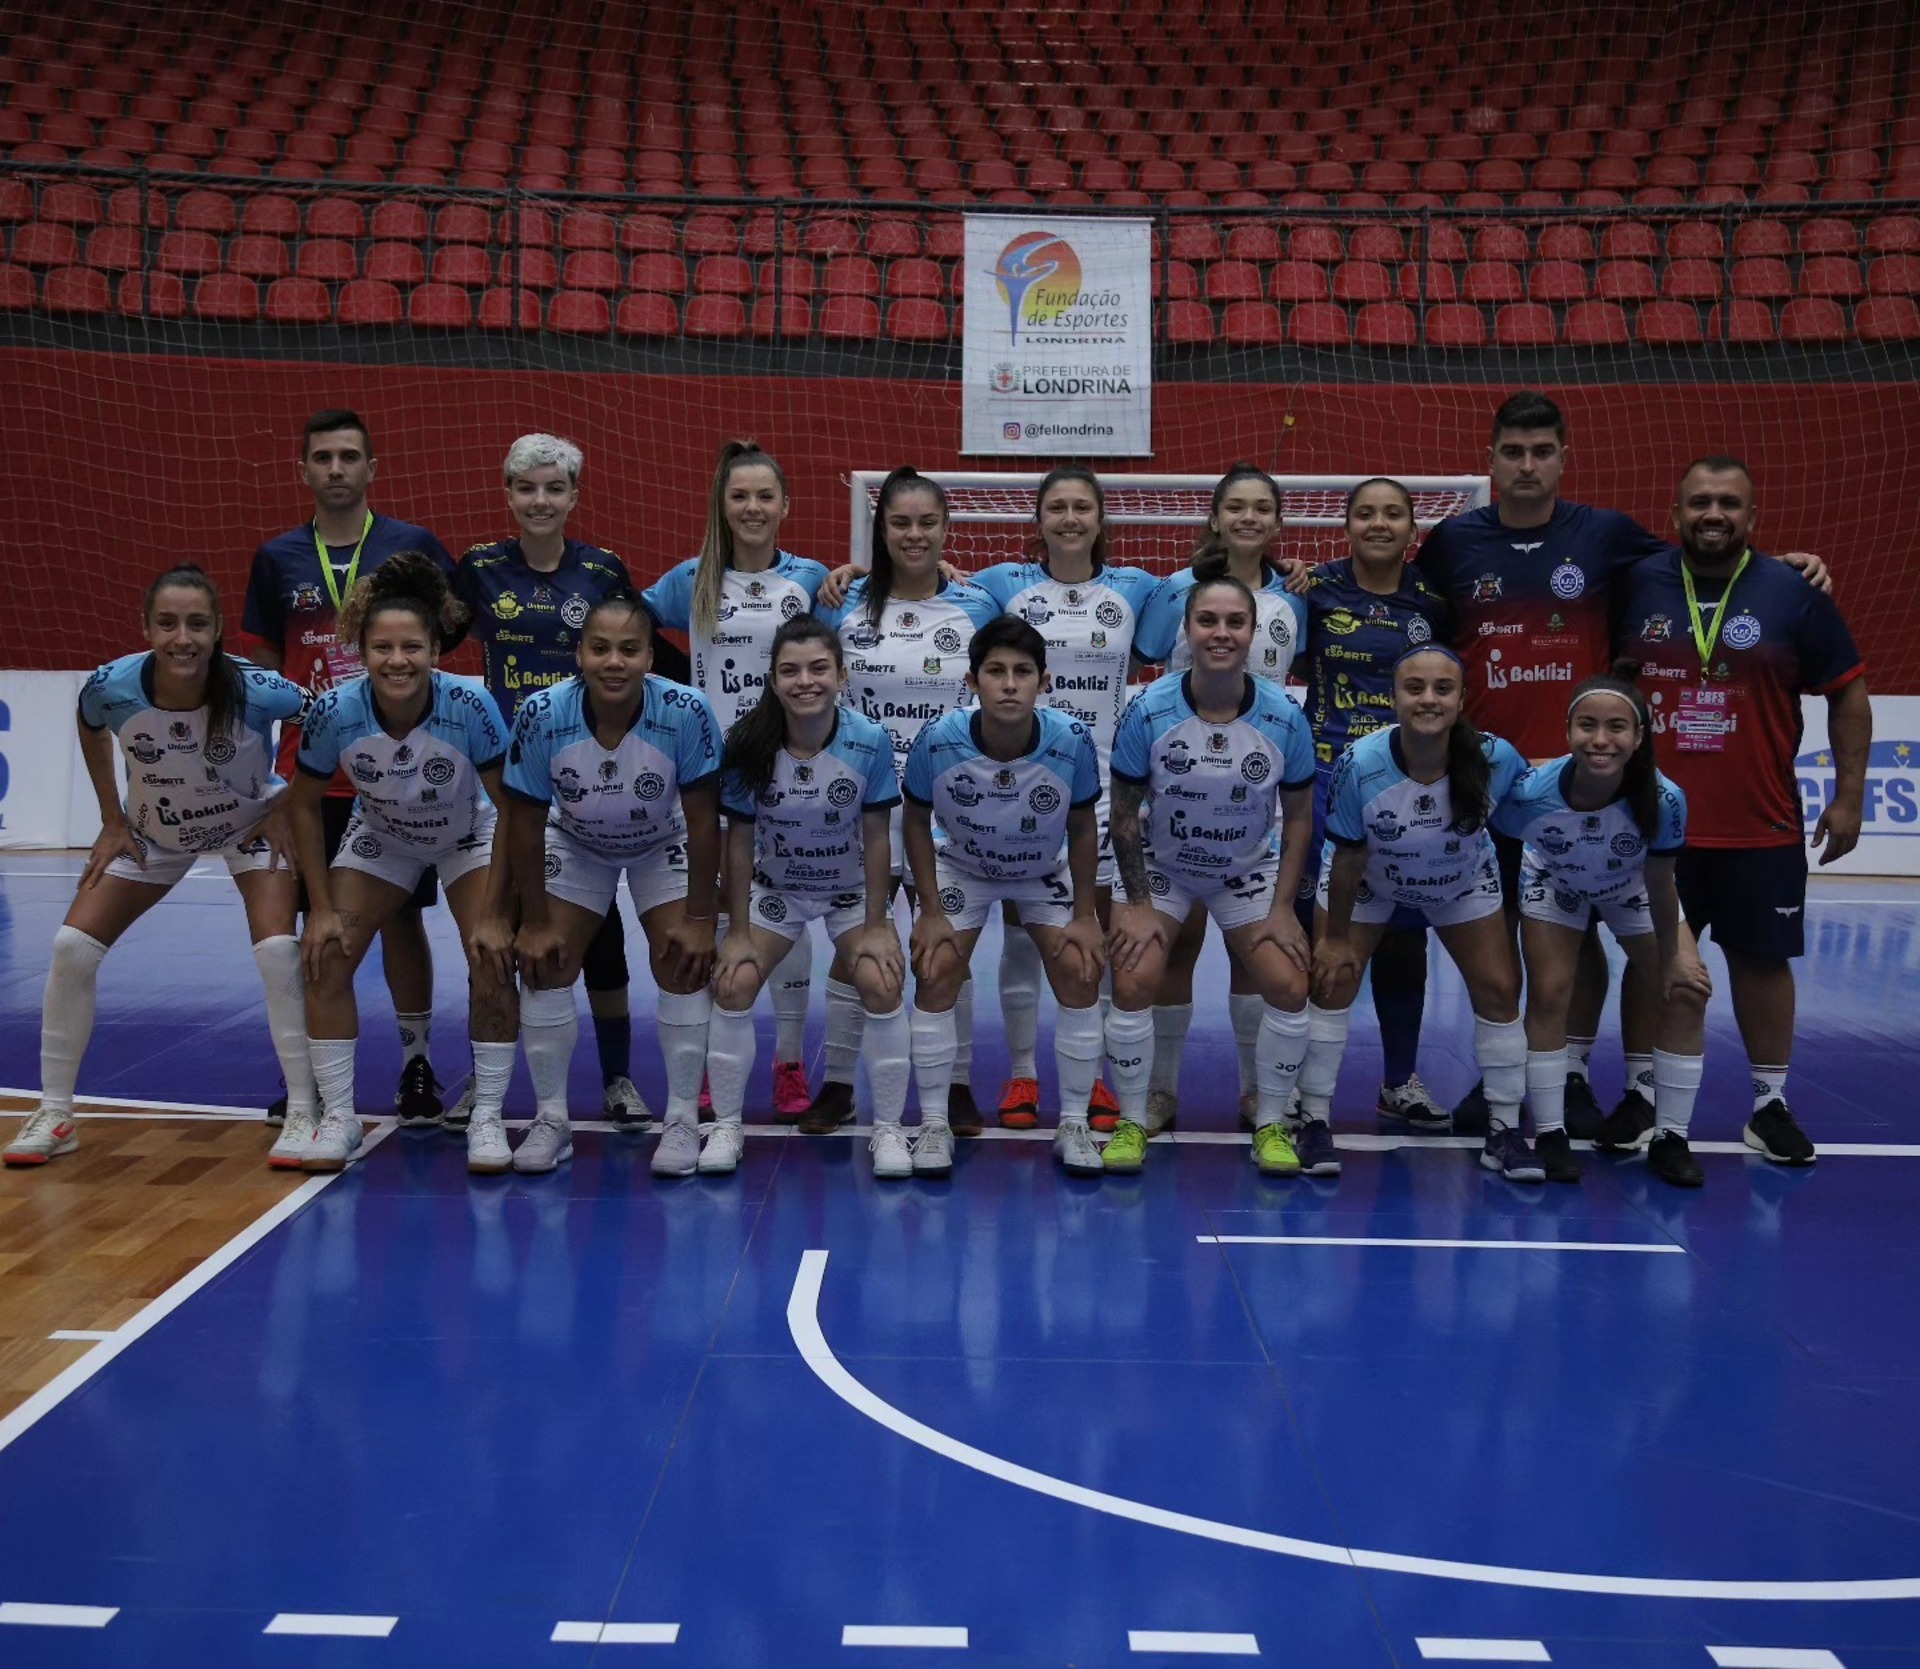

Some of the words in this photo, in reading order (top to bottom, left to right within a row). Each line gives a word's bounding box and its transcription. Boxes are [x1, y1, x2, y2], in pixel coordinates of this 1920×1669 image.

[1035, 288, 1121, 310] Fundação
[1027, 310, 1048, 327] de
[1054, 310, 1129, 331] Esportes
[1025, 336, 1126, 345] LONDRINA
[1023, 365, 1110, 377] PREFEITURA
[1113, 366, 1131, 377] DE
[1023, 378, 1132, 394] LONDRINA
[1025, 423, 1114, 439] @fellondrina
[1478, 624, 1524, 636] ESPORTE
[1325, 648, 1373, 662] ESPORTE
[1510, 662, 1573, 682] Baklizi
[1642, 667, 1688, 679] ESPORTE
[1055, 675, 1109, 691] Baklizi
[1200, 755, 1233, 765] Unimed
[1410, 816, 1442, 827] Unimed
[1191, 826, 1248, 841] Baklizi
[794, 842, 850, 858] Baklizi
[785, 867, 840, 878] MISSÕES
